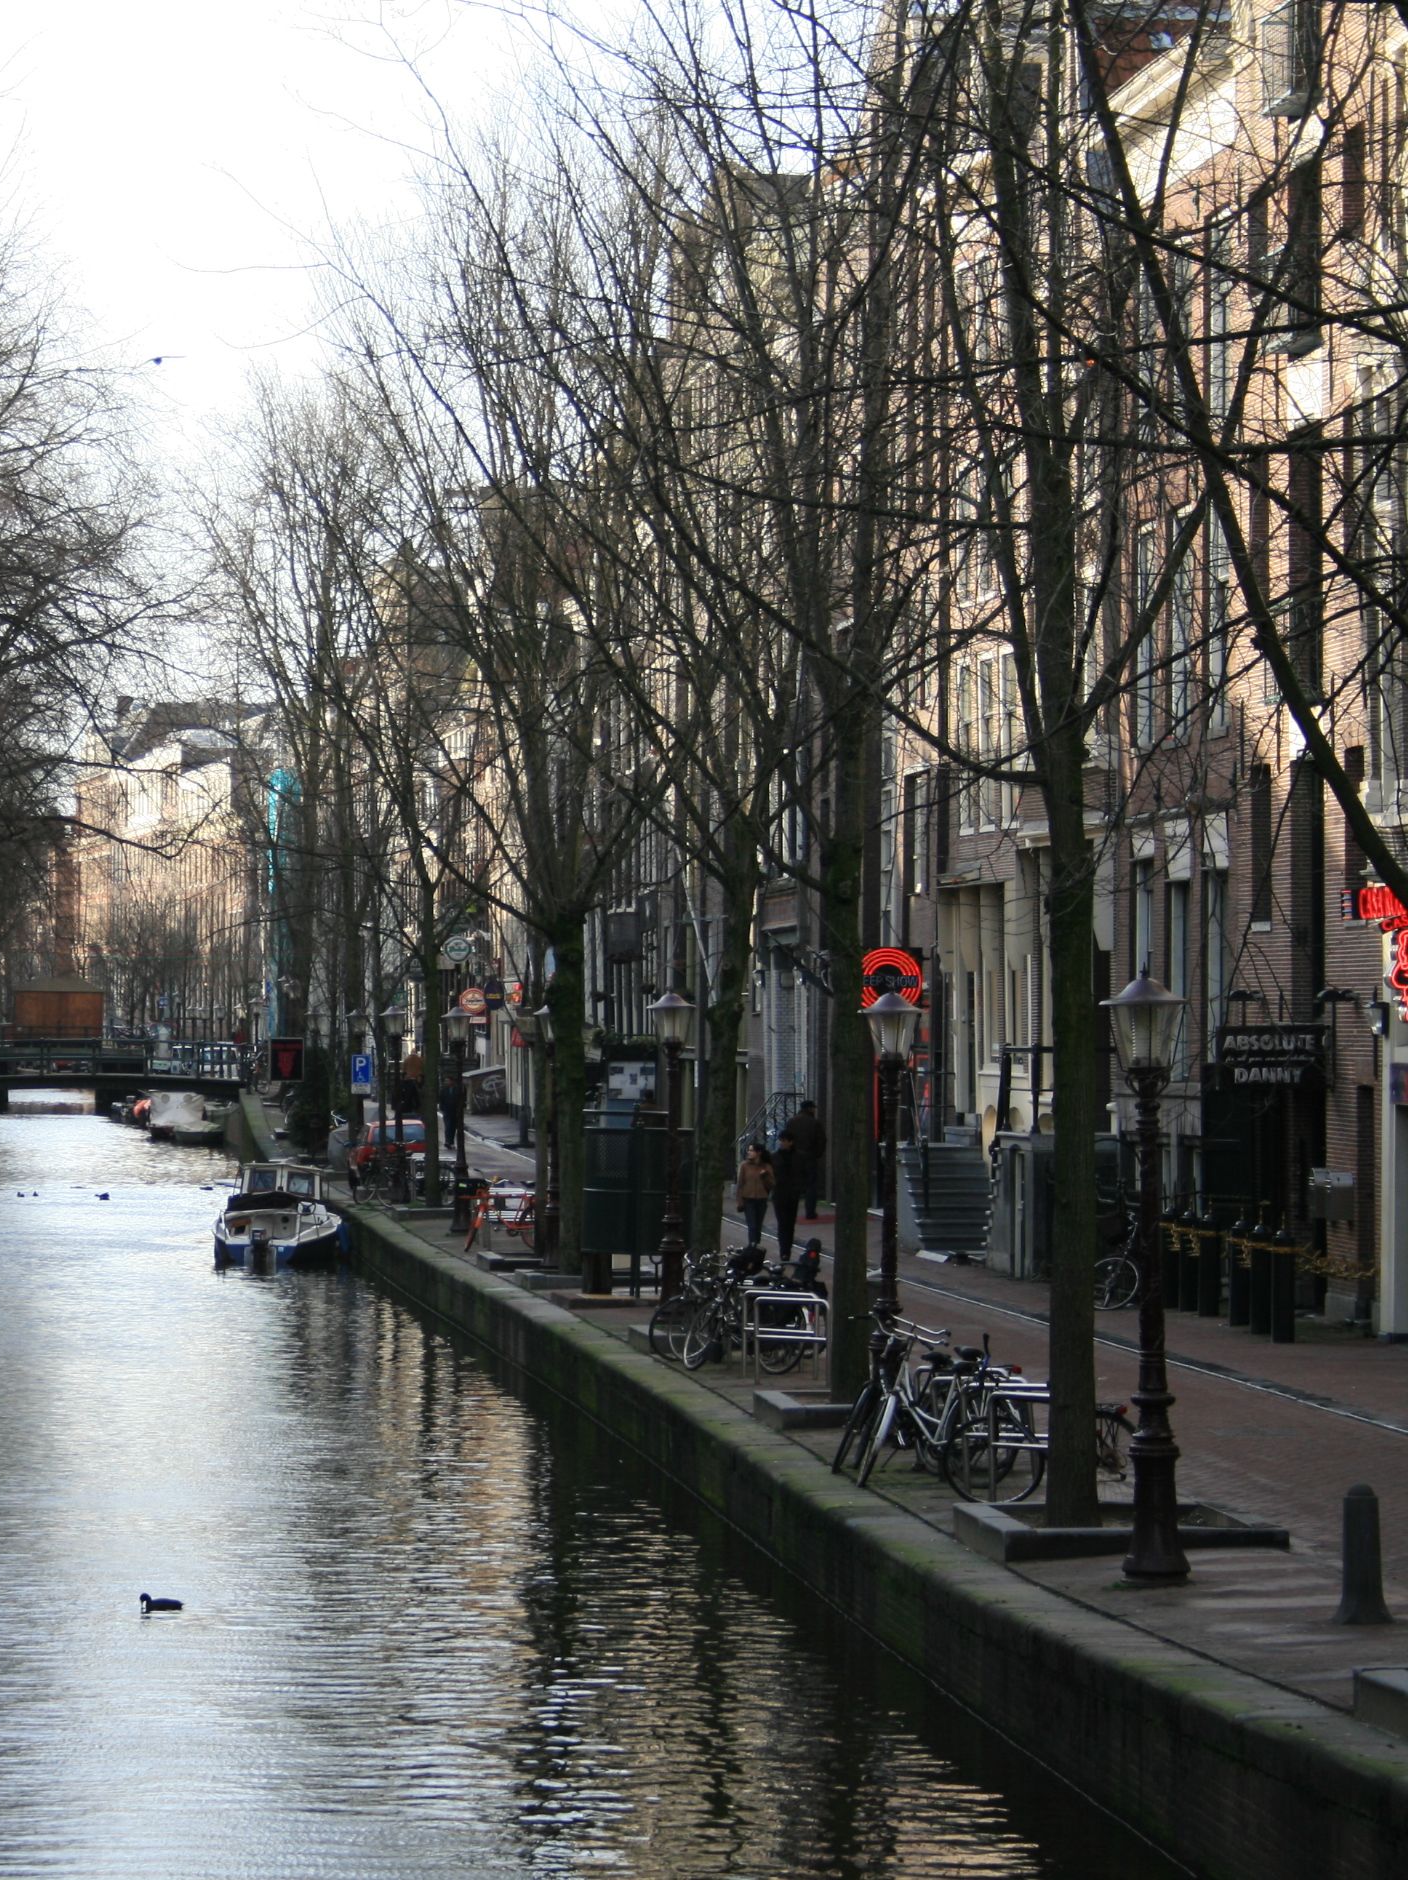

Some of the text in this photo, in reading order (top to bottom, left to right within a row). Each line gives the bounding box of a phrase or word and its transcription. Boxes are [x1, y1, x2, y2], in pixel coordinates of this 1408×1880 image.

[863, 975, 883, 986] EEP
[1222, 1034, 1316, 1051] ABSOLUTE
[355, 1057, 367, 1072] P
[1234, 1066, 1305, 1084] DANNY
